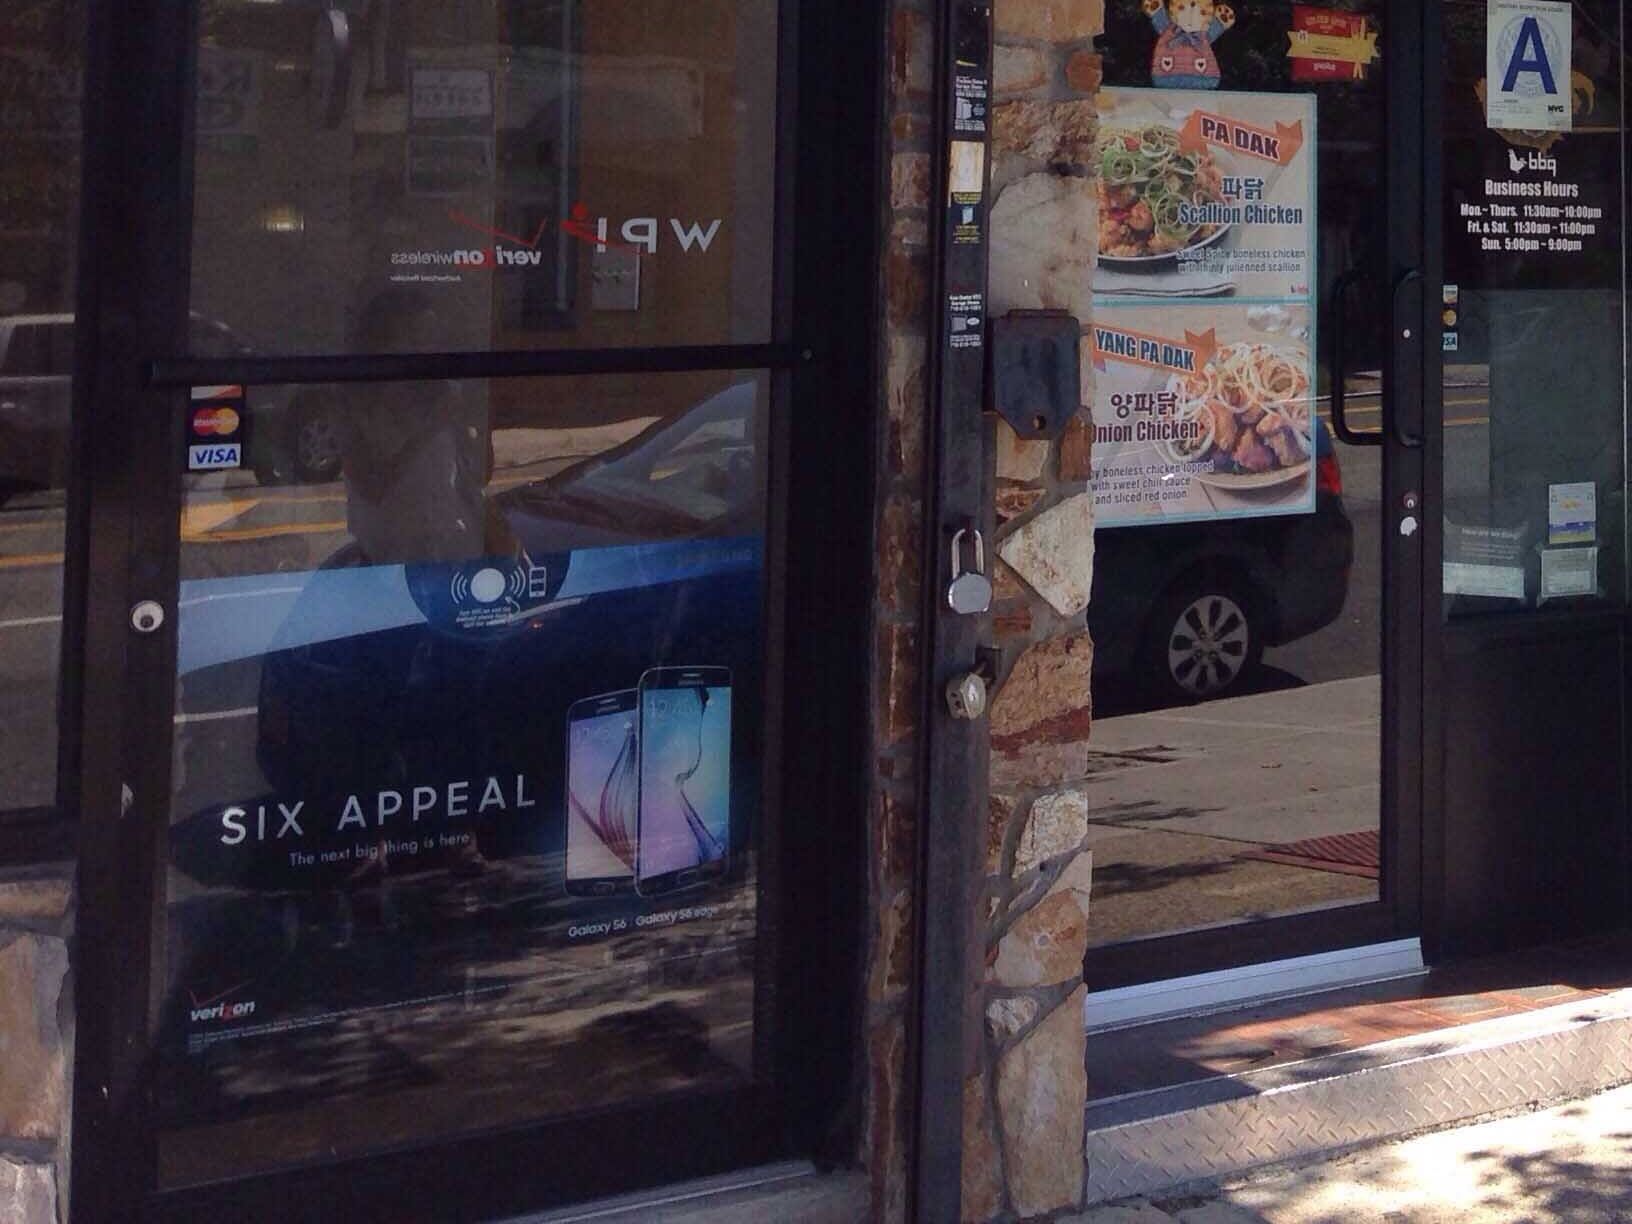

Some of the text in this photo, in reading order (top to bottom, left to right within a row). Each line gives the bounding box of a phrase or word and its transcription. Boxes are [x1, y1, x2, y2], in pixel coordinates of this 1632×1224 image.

[1501, 17, 1558, 95] A
[1200, 117, 1280, 160] PA DAK
[1528, 151, 1557, 177] bbq
[1485, 179, 1579, 197] Business Hours
[1180, 204, 1303, 225] Scallion Chicken
[1095, 329, 1195, 371] YANG PA DAK
[1110, 392, 1178, 419] 양파닭
[1136, 421, 1199, 441] Chicken
[195, 447, 238, 464] VISA
[219, 773, 537, 846] SIX APPEAL
[289, 831, 471, 867] The next big thing is here
[568, 920, 611, 937] Galaxy
[612, 919, 627, 931] S6
[635, 910, 678, 928] Galaxy
